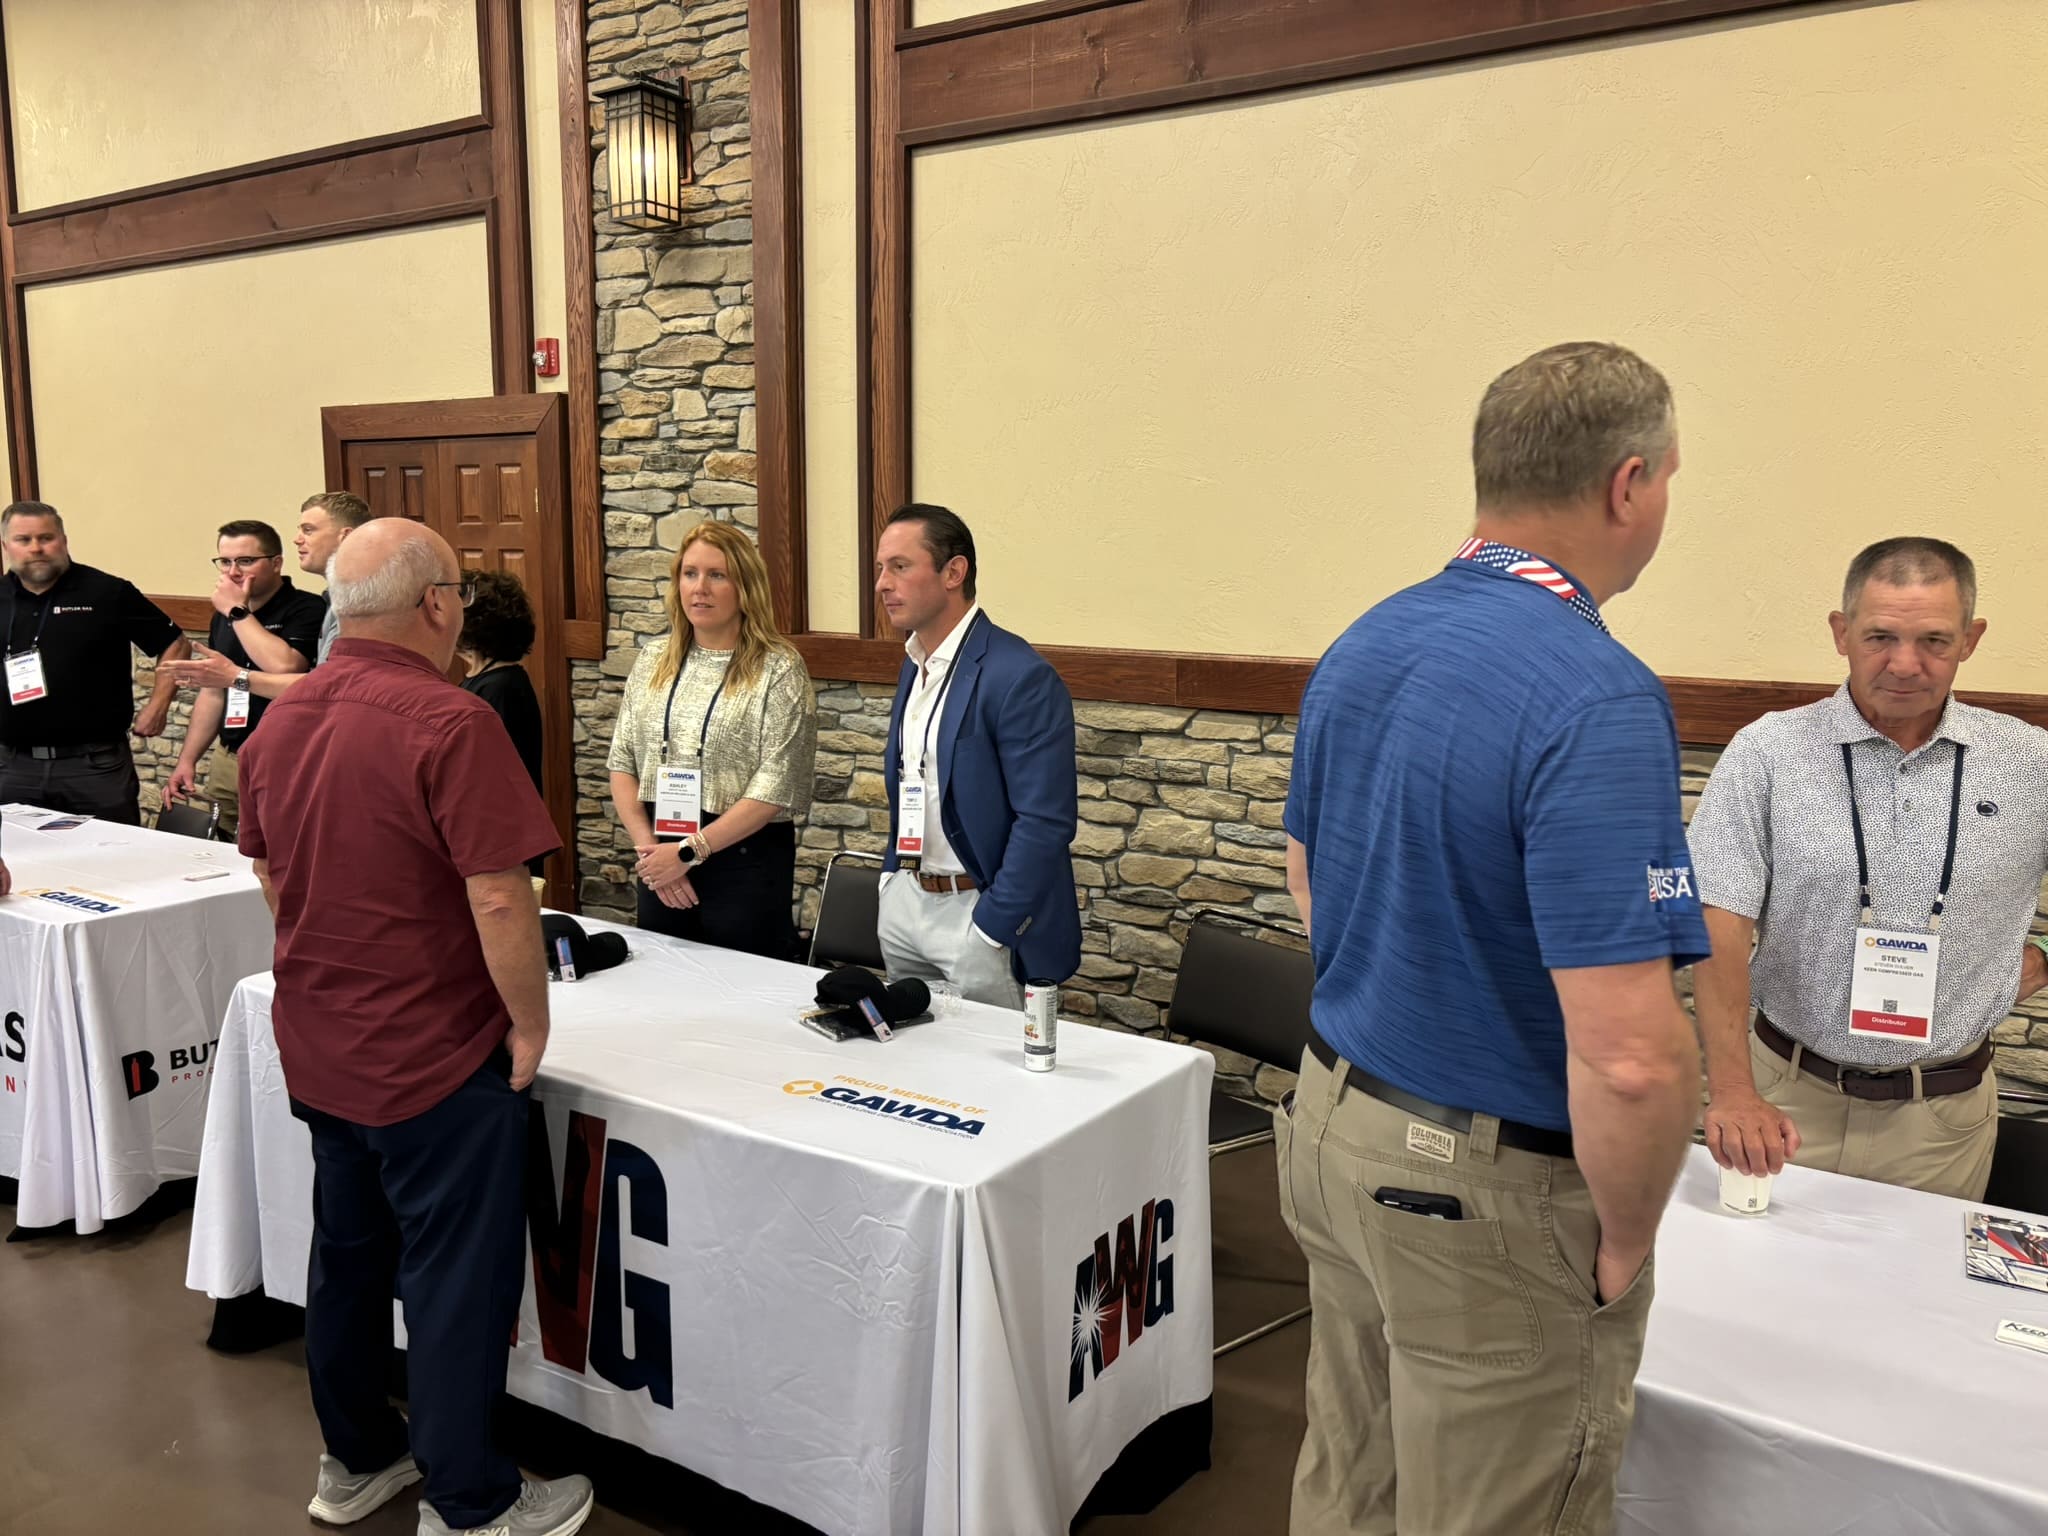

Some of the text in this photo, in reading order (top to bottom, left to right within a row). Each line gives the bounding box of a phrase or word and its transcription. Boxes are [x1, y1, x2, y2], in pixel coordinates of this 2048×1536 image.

[1652, 875, 1694, 899] USA
[1876, 938, 1929, 951] GAWDA
[1881, 954, 1908, 964] STEVE
[1871, 1016, 1907, 1027] Distributor
[0, 1011, 26, 1063] S
[833, 1074, 989, 1115] PROUD MEMBER OF
[820, 1087, 986, 1136] GAWDA
[1411, 1126, 1452, 1149] COLUMBIA
[1068, 1197, 1174, 1404] AWG
